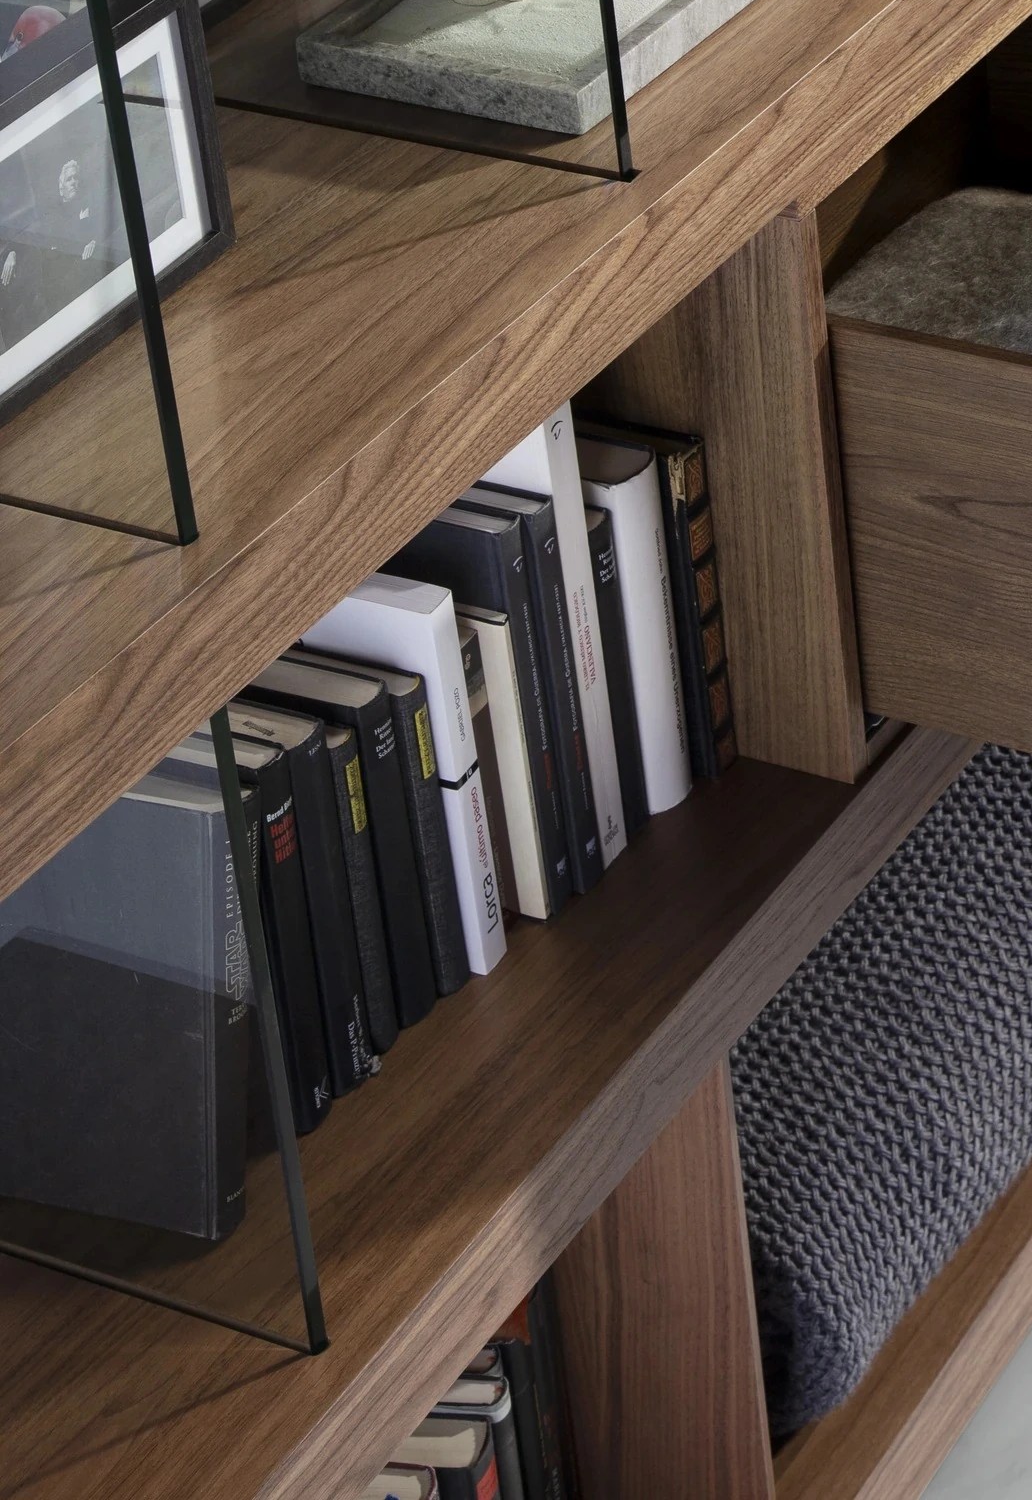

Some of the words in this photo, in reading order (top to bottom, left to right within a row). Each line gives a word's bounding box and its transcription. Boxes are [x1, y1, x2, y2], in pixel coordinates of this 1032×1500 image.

[266, 806, 284, 823] Bernd
[470, 786, 482, 823] paseo
[225, 852, 234, 919] EPISODE
[483, 871, 499, 935] Lorca
[225, 919, 244, 998] STAR
